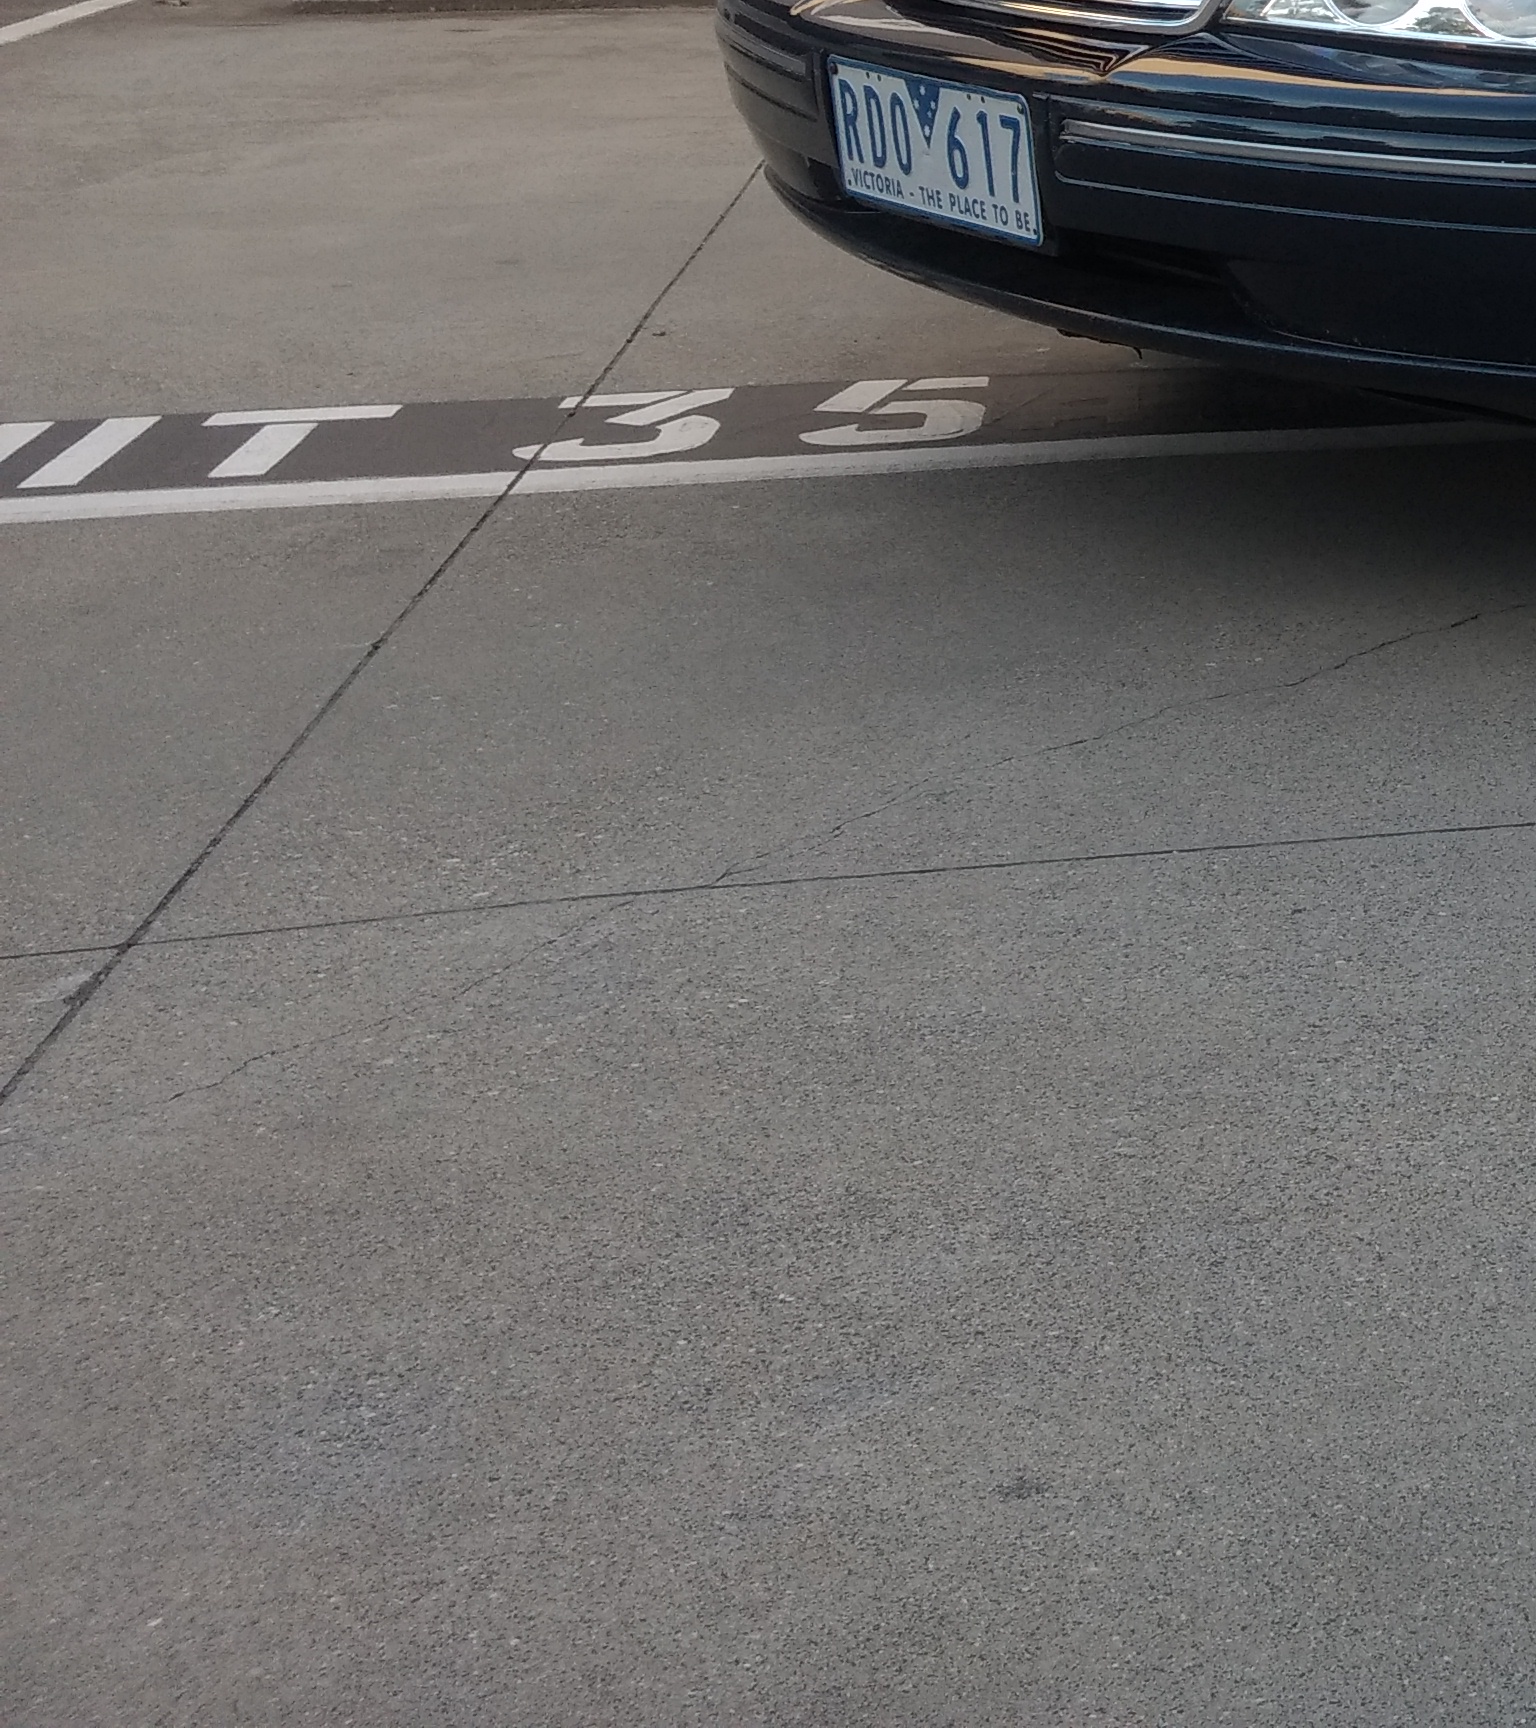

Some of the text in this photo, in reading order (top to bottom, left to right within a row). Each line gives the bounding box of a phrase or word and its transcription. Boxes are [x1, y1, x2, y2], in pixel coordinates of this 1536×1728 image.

[851, 168, 904, 199] VICTORIA
[919, 186, 943, 209] THE
[950, 193, 987, 221] PLACE
[992, 203, 1008, 226] TO
[947, 106, 1020, 204] 617
[512, 376, 990, 461] 35
